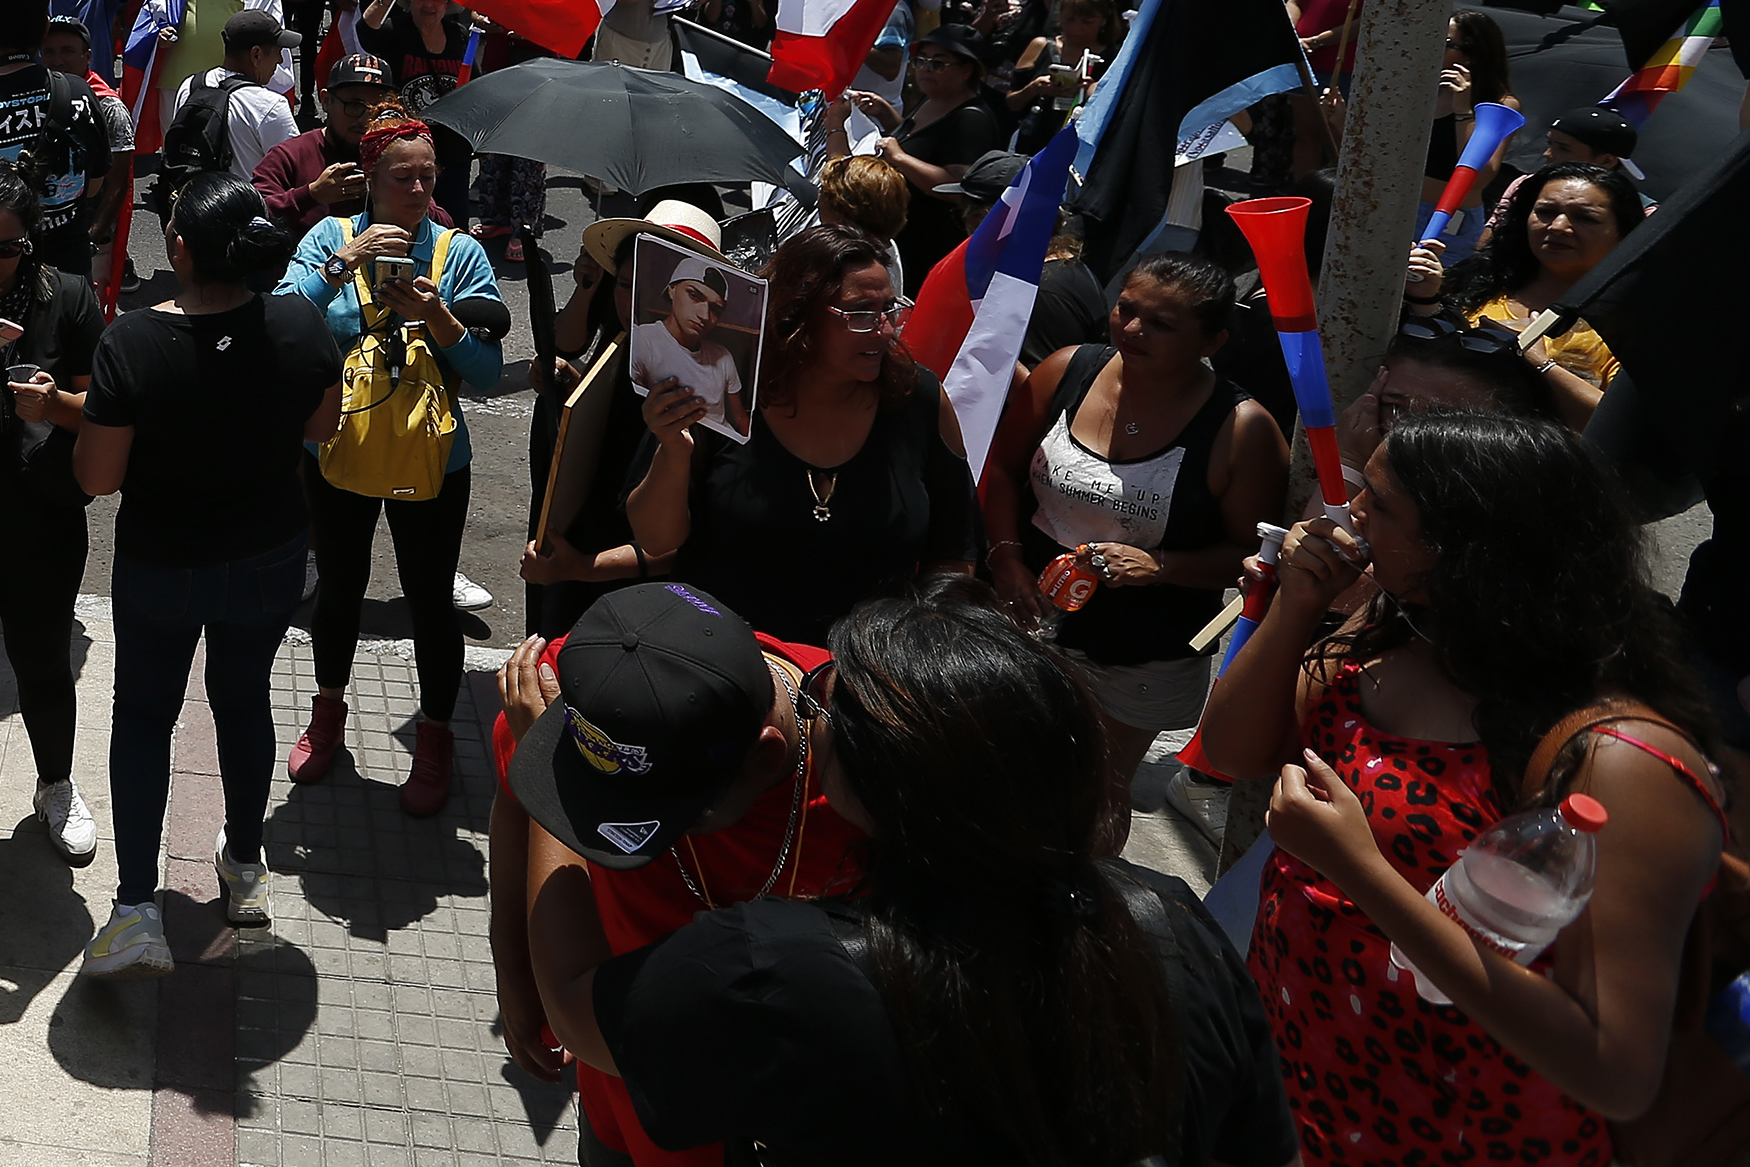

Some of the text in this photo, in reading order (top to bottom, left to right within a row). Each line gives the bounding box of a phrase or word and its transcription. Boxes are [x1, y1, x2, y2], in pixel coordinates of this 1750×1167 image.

[1036, 455, 1161, 505] WAKE ME UP
[1058, 483, 1106, 507] SUMMER
[1112, 499, 1158, 521] BEGINS
[1069, 578, 1093, 600] G
